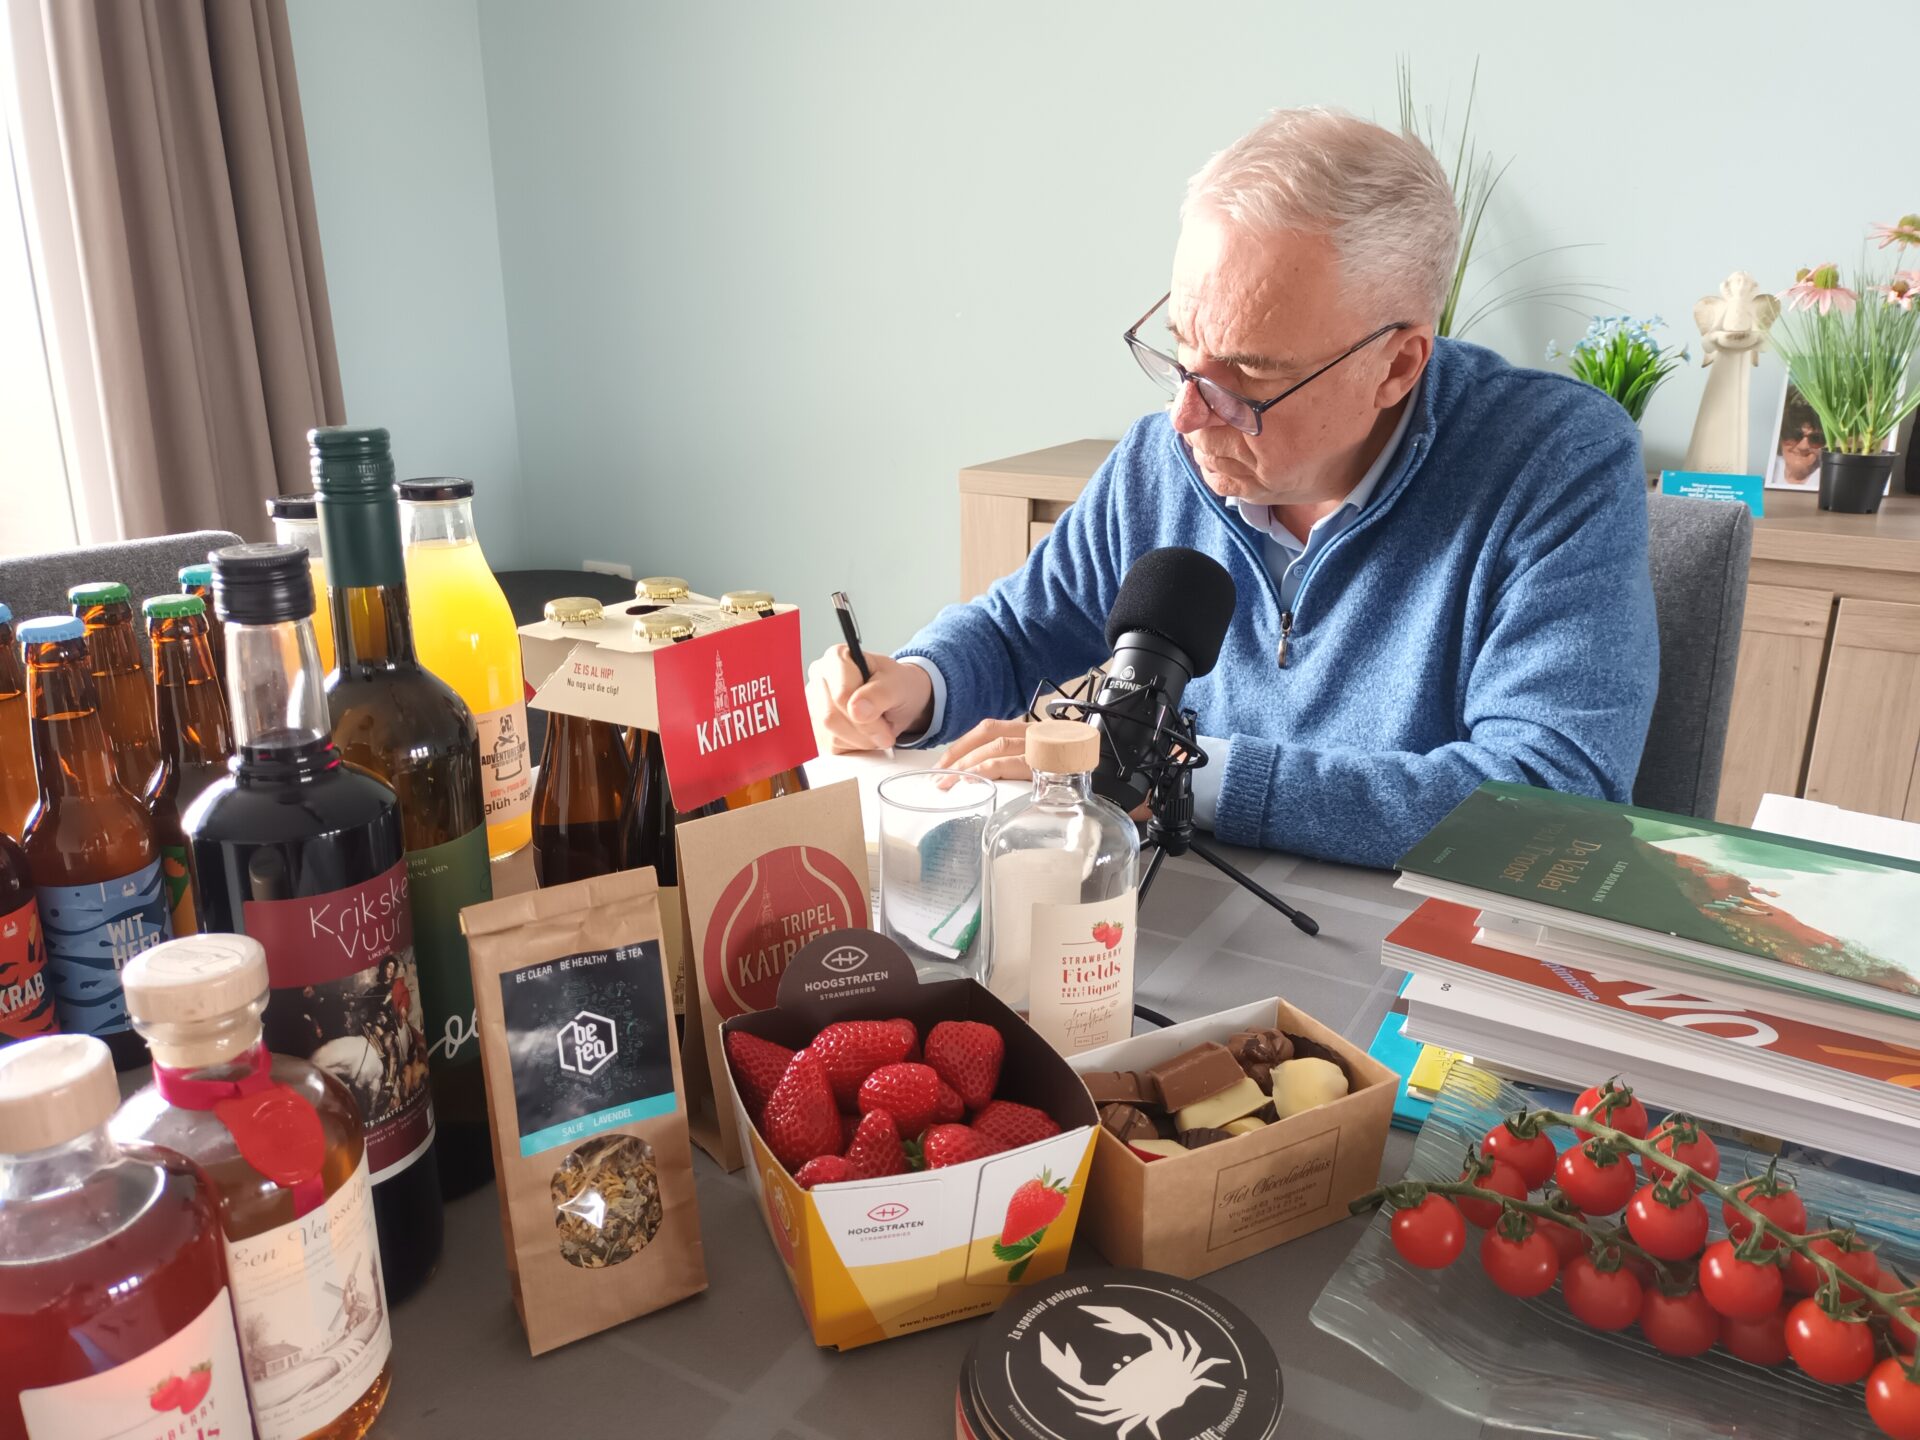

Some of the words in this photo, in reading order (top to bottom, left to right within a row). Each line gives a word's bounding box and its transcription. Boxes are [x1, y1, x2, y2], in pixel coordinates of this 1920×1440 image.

[574, 662, 581, 675] ZE
[583, 665, 589, 676] IS
[591, 666, 598, 677] AL
[600, 667, 614, 680] HIP!
[730, 675, 775, 707] TRIPEL
[696, 697, 780, 756] KATRIEN
[485, 796, 511, 815] glüh
[1571, 839, 1602, 857] De
[1537, 858, 1590, 893] Vallei
[309, 876, 408, 938] Krikske
[780, 903, 836, 937] TRIPEL
[106, 912, 144, 945] WIT
[516, 972, 527, 984] BE
[528, 965, 553, 981] CLEAR
[559, 959, 571, 971] BE
[572, 954, 608, 969] HEALTHY
[615, 951, 626, 962] BE
[627, 947, 644, 959] TEA
[1061, 947, 1122, 965] STRAWBERRY
[804, 969, 889, 993] HOOGSTRATEN
[1062, 960, 1121, 985] Fields
[1540, 959, 1600, 1001] ptimisme
[819, 986, 876, 1001] STRAWBERRIES
[573, 1021, 598, 1046] be
[561, 1121, 584, 1138] SALIE
[593, 1107, 633, 1128] LAVENDEL
[847, 1220, 925, 1236] HOOGSTRATEN
[860, 1231, 911, 1242] STRAWBERRIES
[899, 1300, 993, 1328] www.hoogstraten.eu
[1016, 1300, 1048, 1331] speciaal
[1046, 1285, 1093, 1307] gebleven.
[1217, 1388, 1248, 1433] BROUWERIJ
